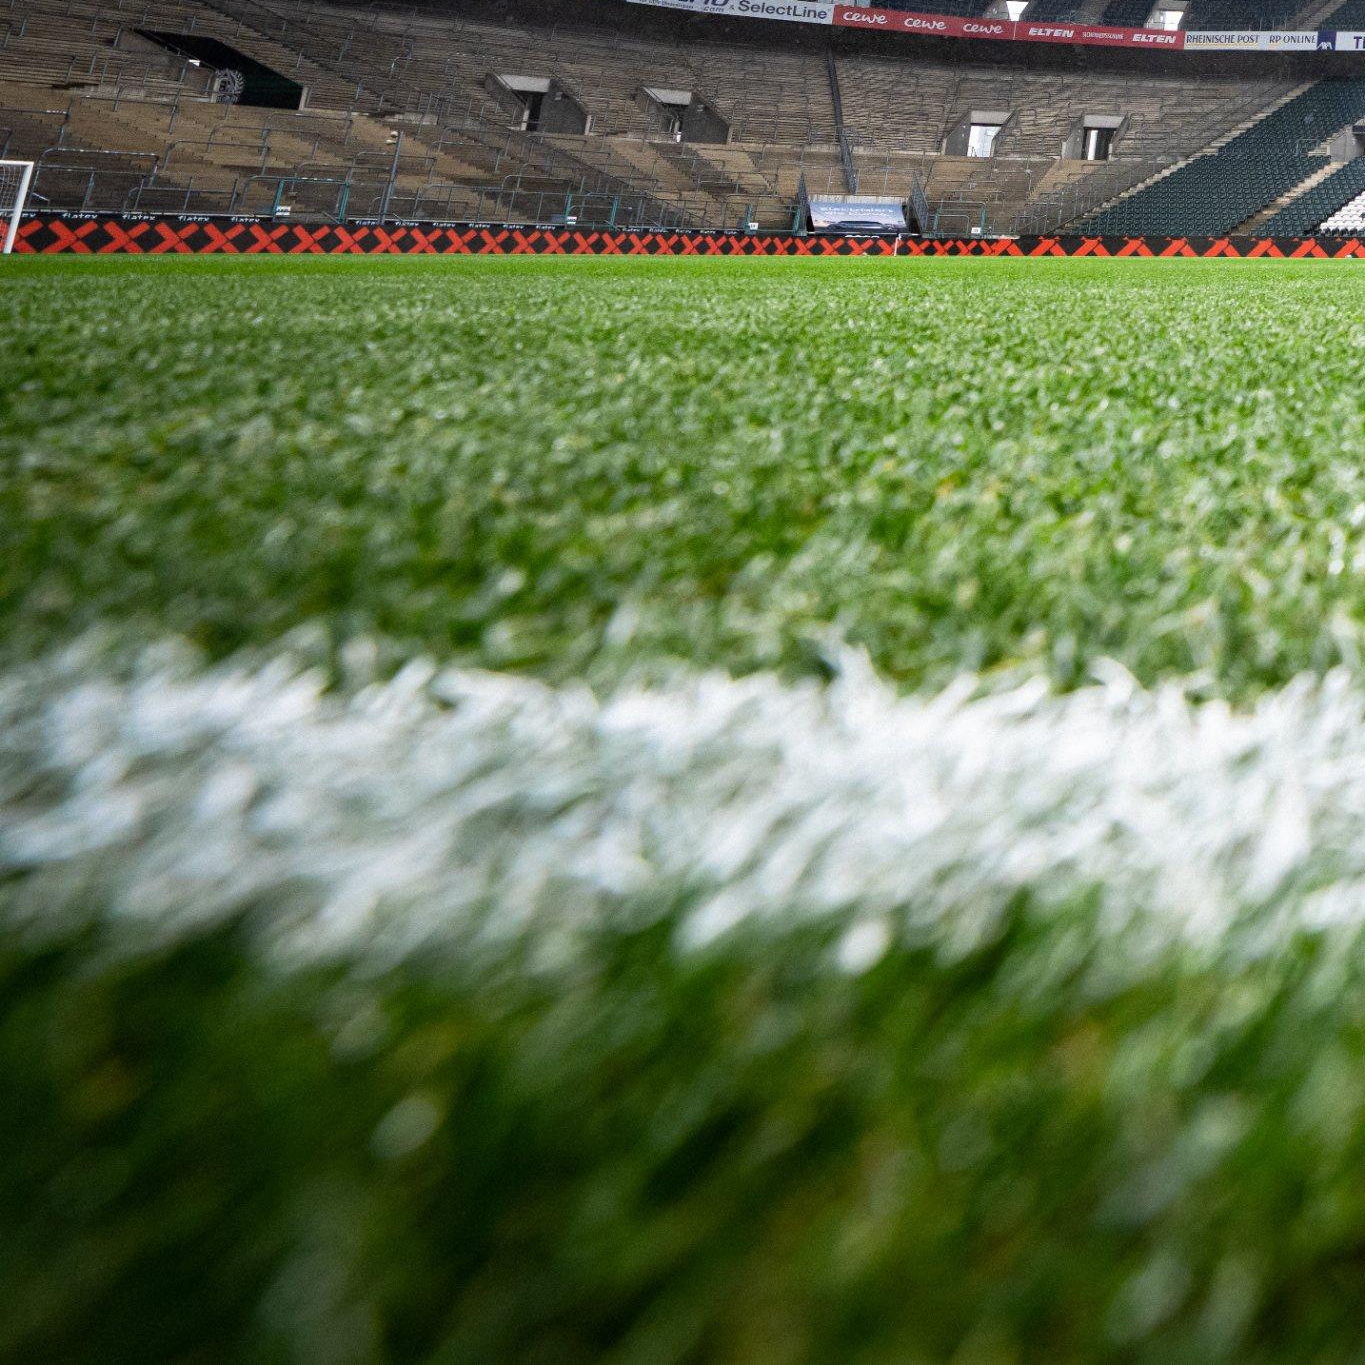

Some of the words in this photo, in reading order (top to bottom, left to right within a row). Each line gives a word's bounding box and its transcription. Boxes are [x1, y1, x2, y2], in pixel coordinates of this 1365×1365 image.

[738, 0, 828, 20] SelectLine
[842, 11, 888, 24] cewe
[904, 17, 947, 30] cewe
[962, 23, 1003, 34] cewe
[1028, 27, 1074, 38] ELTEN
[1132, 33, 1176, 44] ELTEN
[1186, 35, 1235, 44] RHEINISCHE
[1237, 35, 1260, 44] POST
[1269, 35, 1281, 44] RP
[1282, 35, 1316, 44] ONLINE
